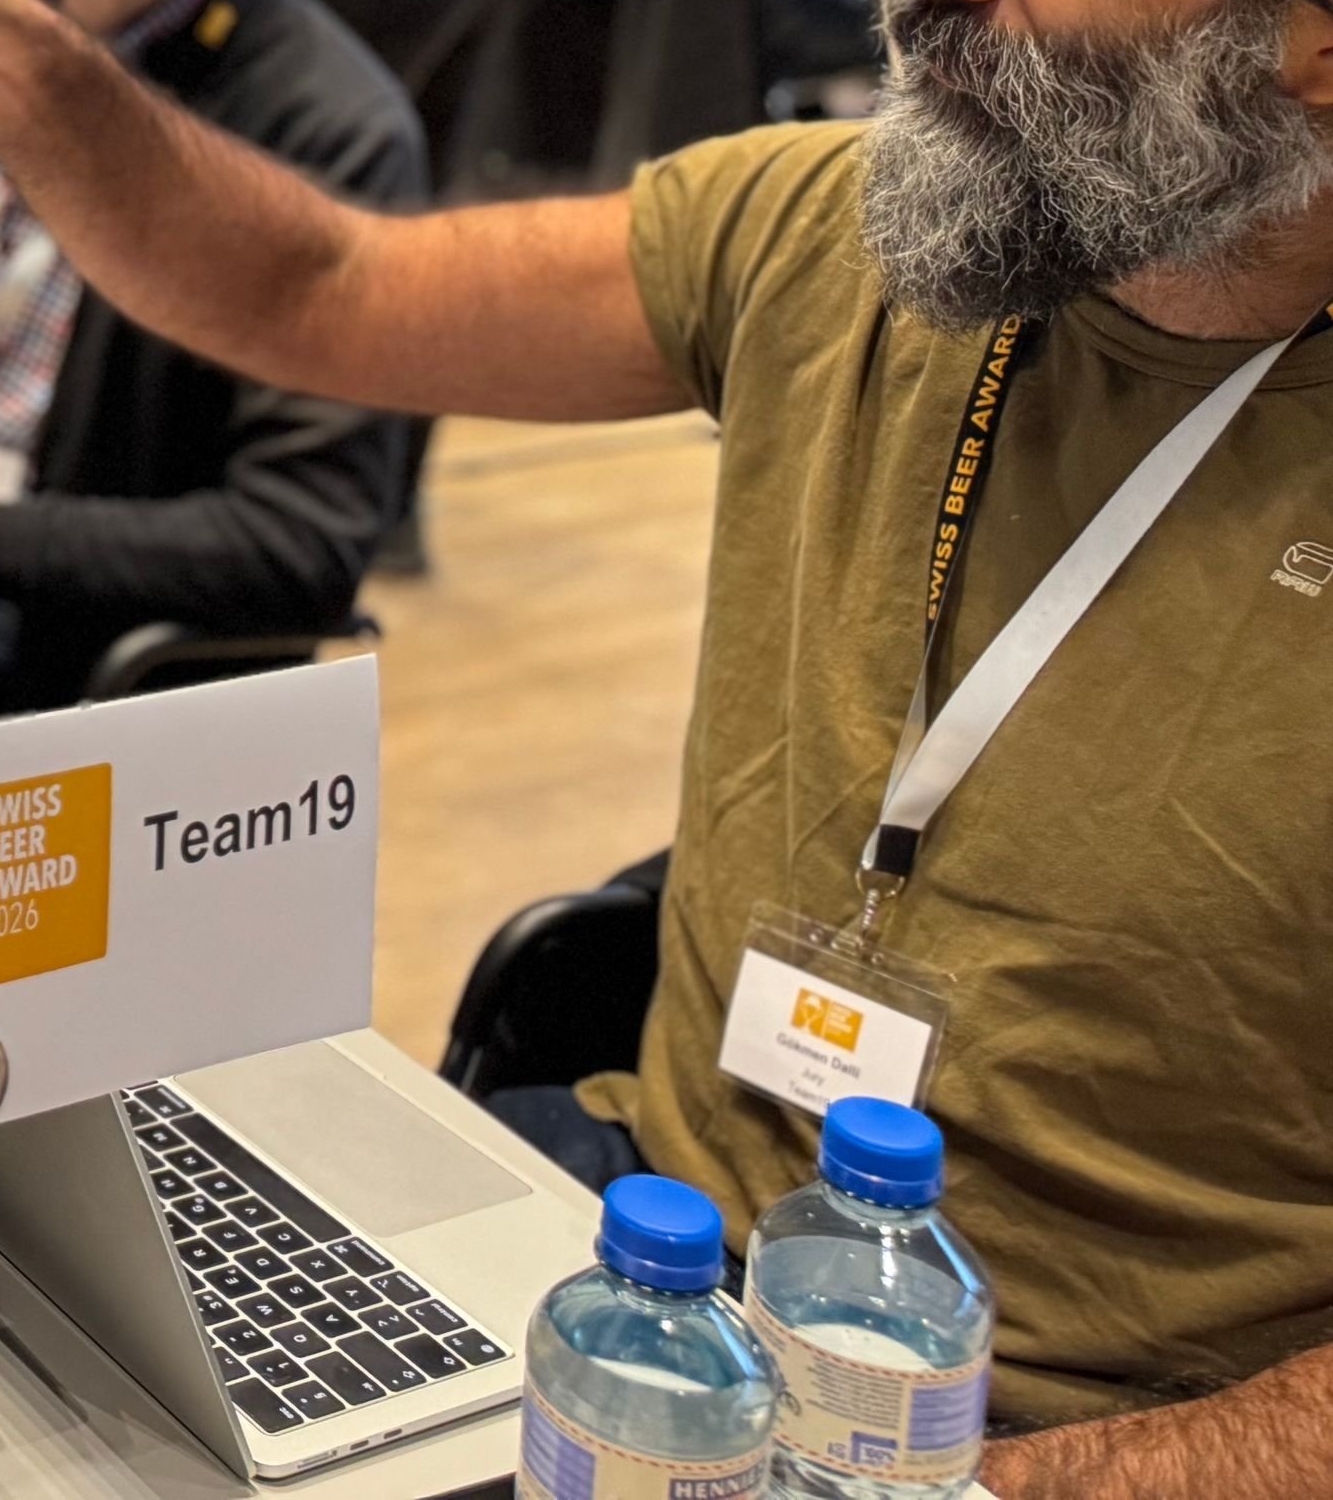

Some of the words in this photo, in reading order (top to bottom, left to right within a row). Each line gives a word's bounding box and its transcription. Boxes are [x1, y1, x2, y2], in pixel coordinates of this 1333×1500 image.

[945, 437, 985, 515] BEER
[971, 312, 1021, 432] AWARD
[144, 774, 355, 871] Team19
[245, 1207, 257, 1215] V
[278, 1233, 291, 1241] C
[193, 1249, 206, 1257] R
[257, 1258, 270, 1266] D
[311, 1260, 325, 1268] X
[225, 1277, 238, 1285] E
[290, 1286, 303, 1294] S
[345, 1289, 358, 1297] Y
[257, 1305, 273, 1315] W
[243, 1330, 256, 1338] 2
